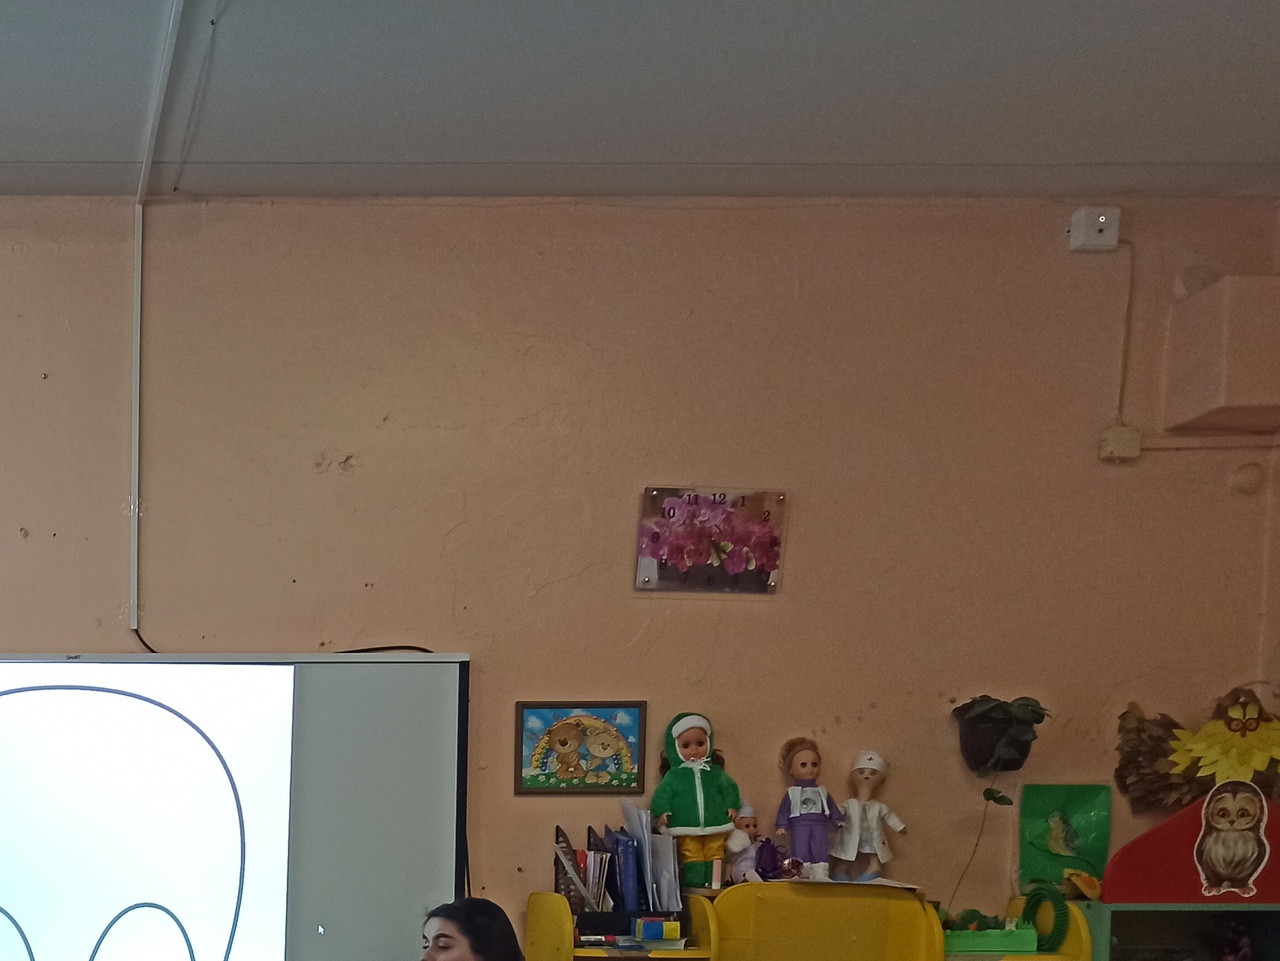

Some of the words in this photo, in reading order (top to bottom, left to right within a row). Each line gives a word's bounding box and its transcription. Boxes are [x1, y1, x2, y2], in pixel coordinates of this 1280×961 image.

[686, 494, 699, 505] 11
[711, 493, 726, 505] 12
[740, 496, 746, 507] 1
[661, 507, 676, 518] 10
[762, 511, 770, 522] 2
[651, 532, 660, 543] 9
